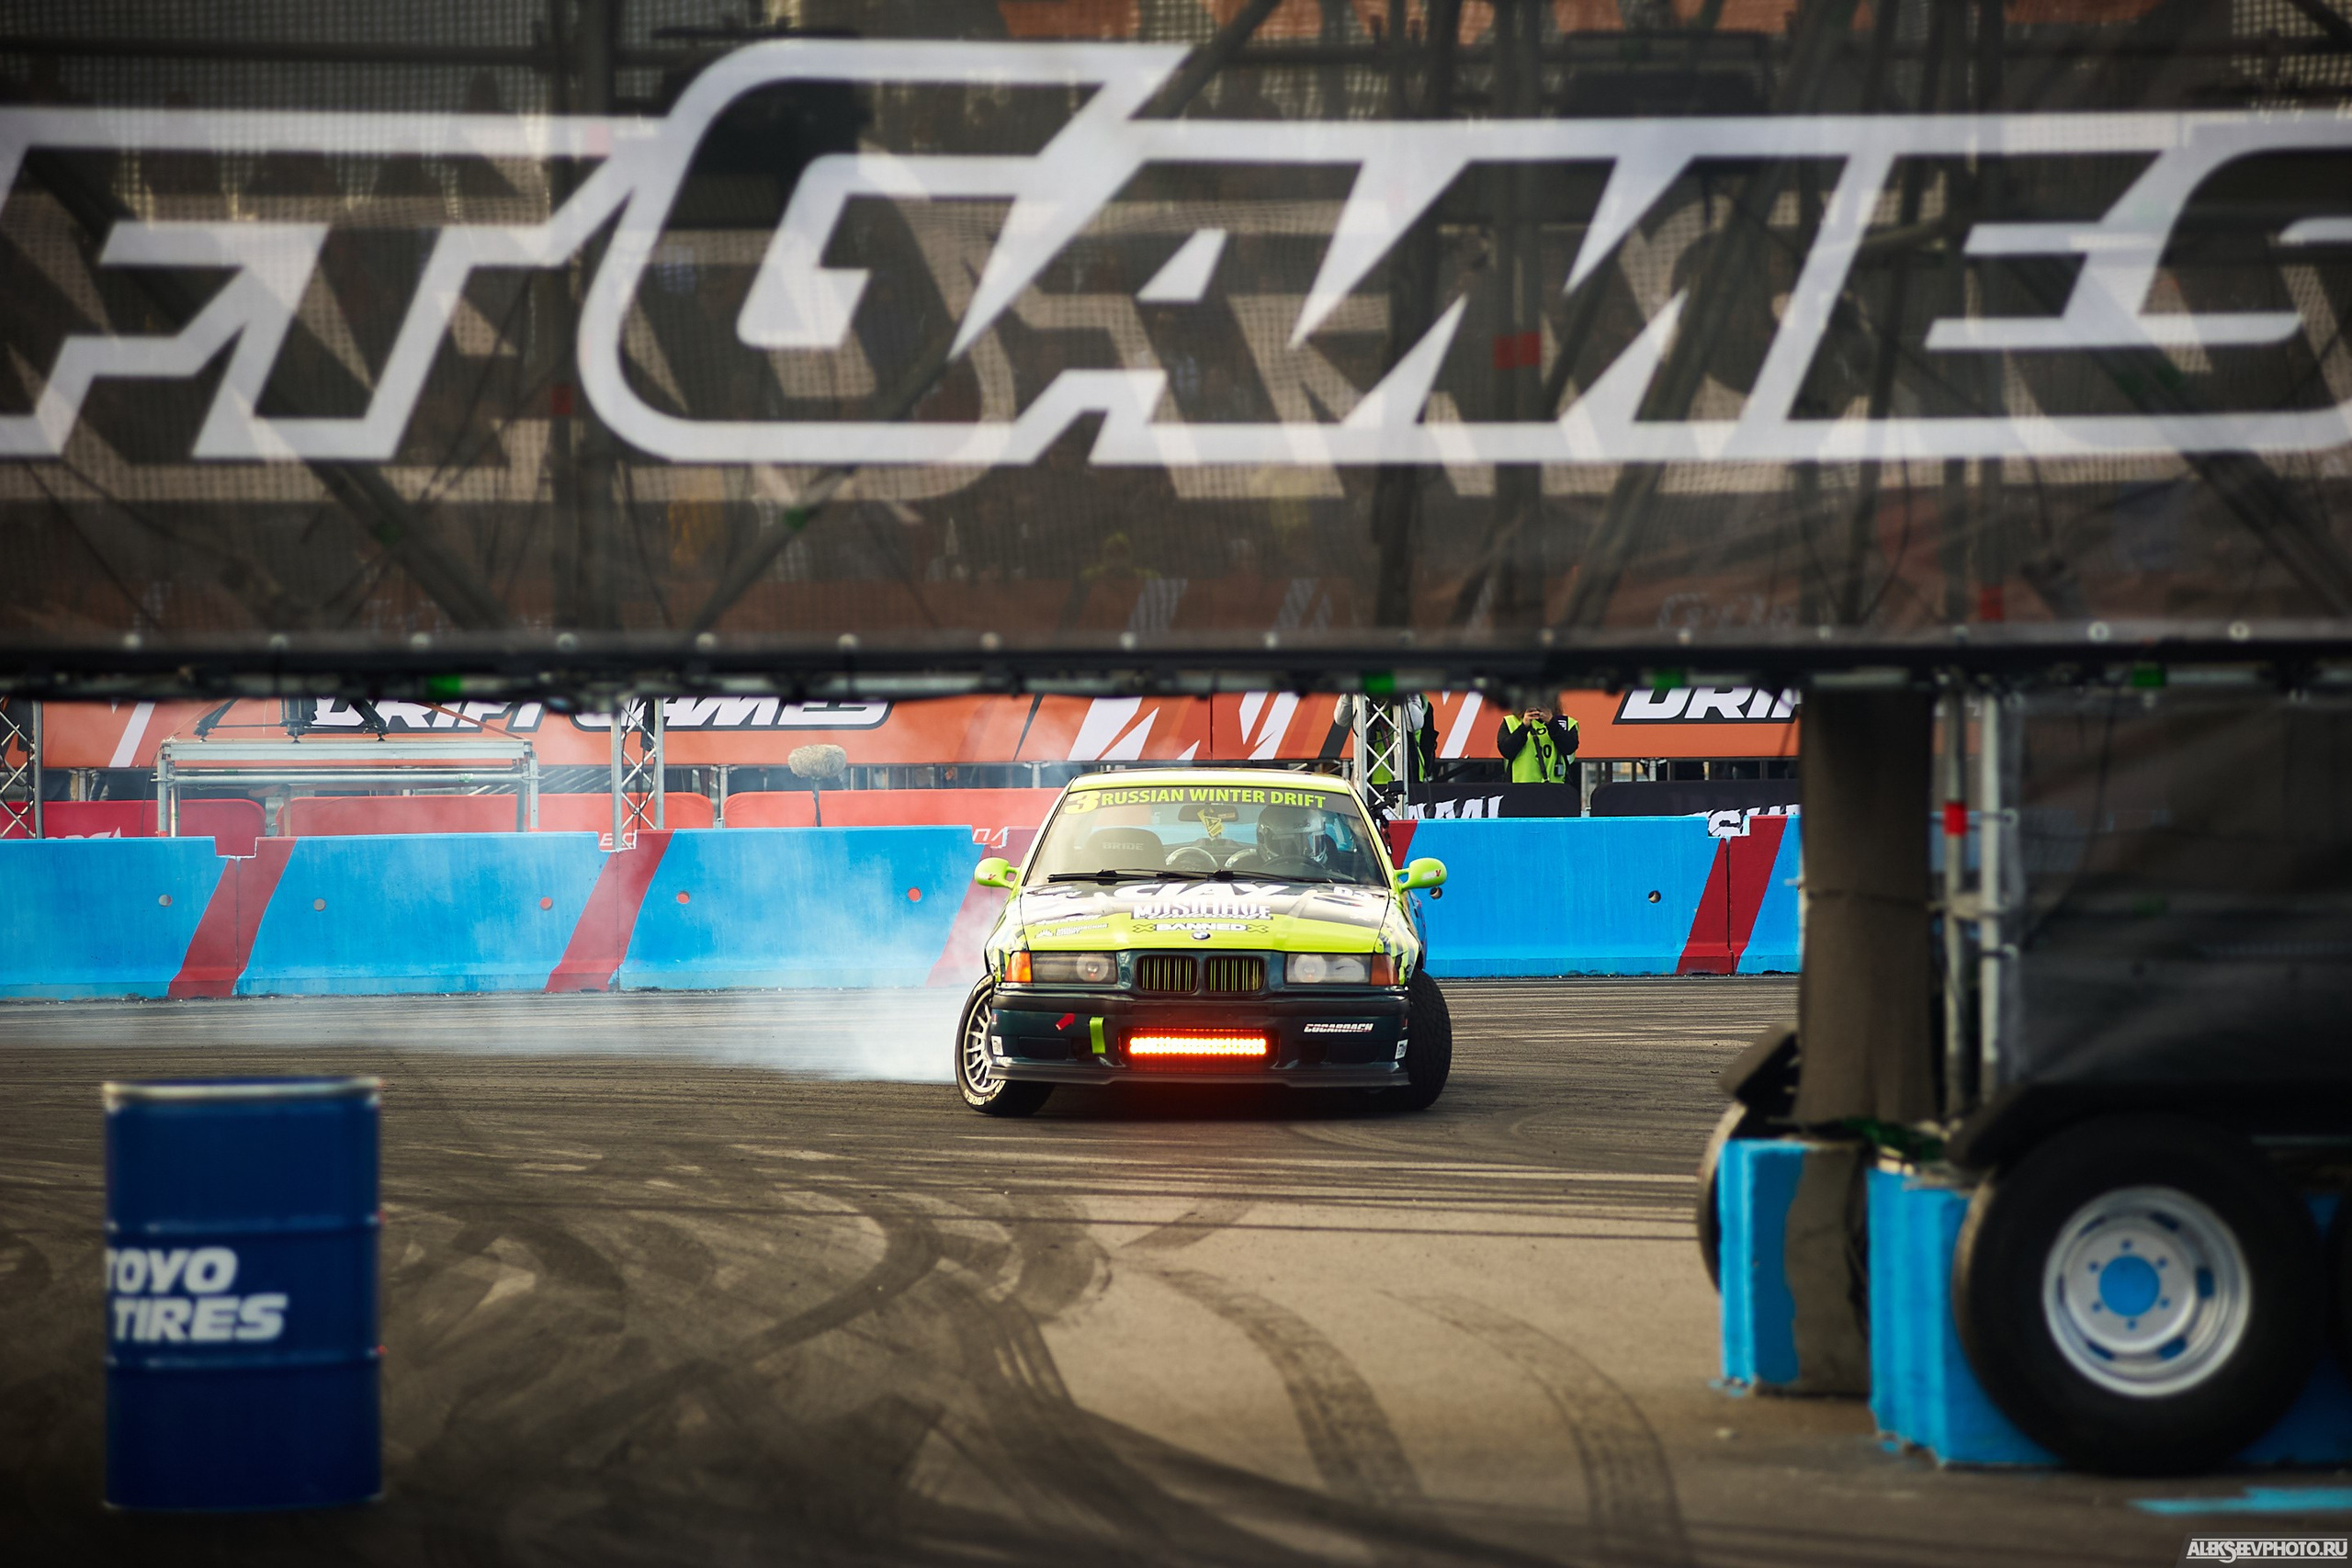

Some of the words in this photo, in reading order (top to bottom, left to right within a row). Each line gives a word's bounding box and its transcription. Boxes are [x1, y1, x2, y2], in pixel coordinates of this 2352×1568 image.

[1064, 790, 1102, 815] 3
[1102, 789, 1184, 807] RUSSIAN
[1189, 788, 1265, 804] WINTER
[1270, 790, 1327, 808] DRIFT
[1102, 841, 1144, 851] BRIDE
[1155, 922, 1248, 931] BANNED
[114, 1292, 289, 1343] TIRES
